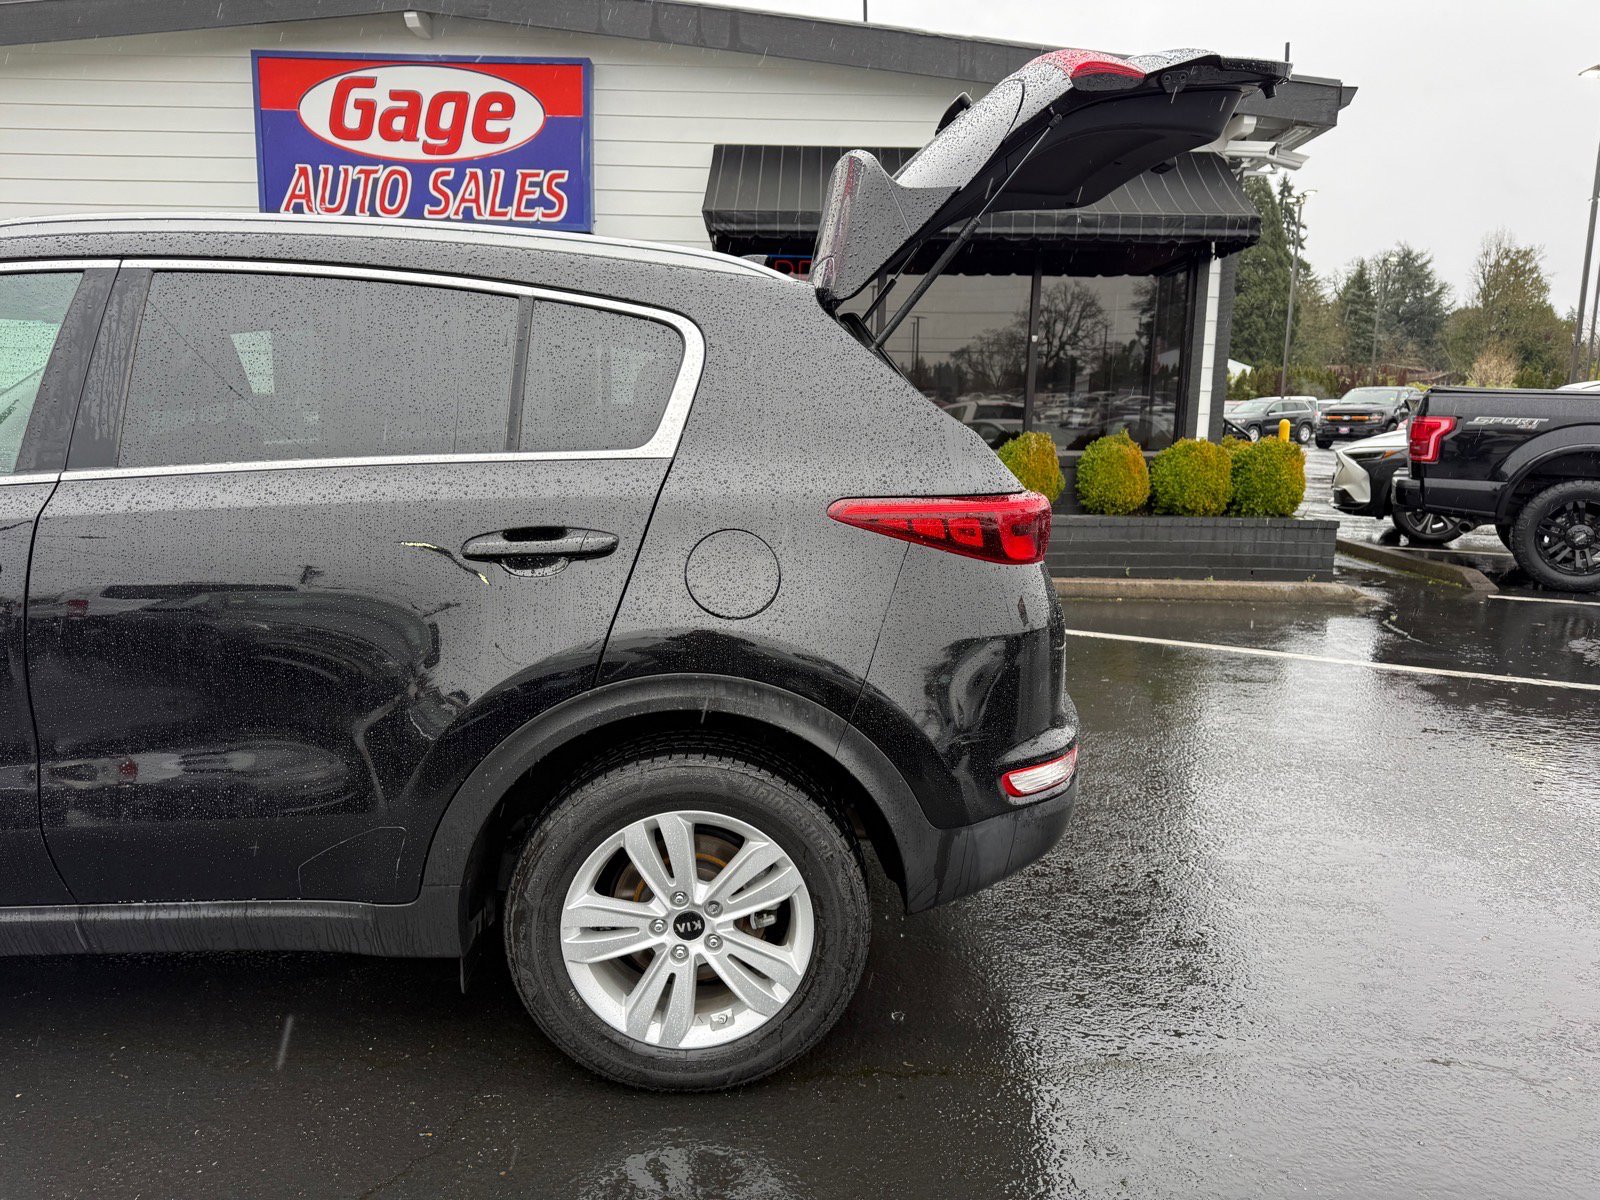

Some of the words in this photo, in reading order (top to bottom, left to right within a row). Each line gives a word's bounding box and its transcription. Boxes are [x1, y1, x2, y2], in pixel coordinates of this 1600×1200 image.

[329, 76, 516, 156] Gage
[280, 164, 412, 218] AUTO
[424, 167, 569, 222] SALES
[1466, 416, 1549, 426] SPORT
[675, 919, 703, 934] KIA
